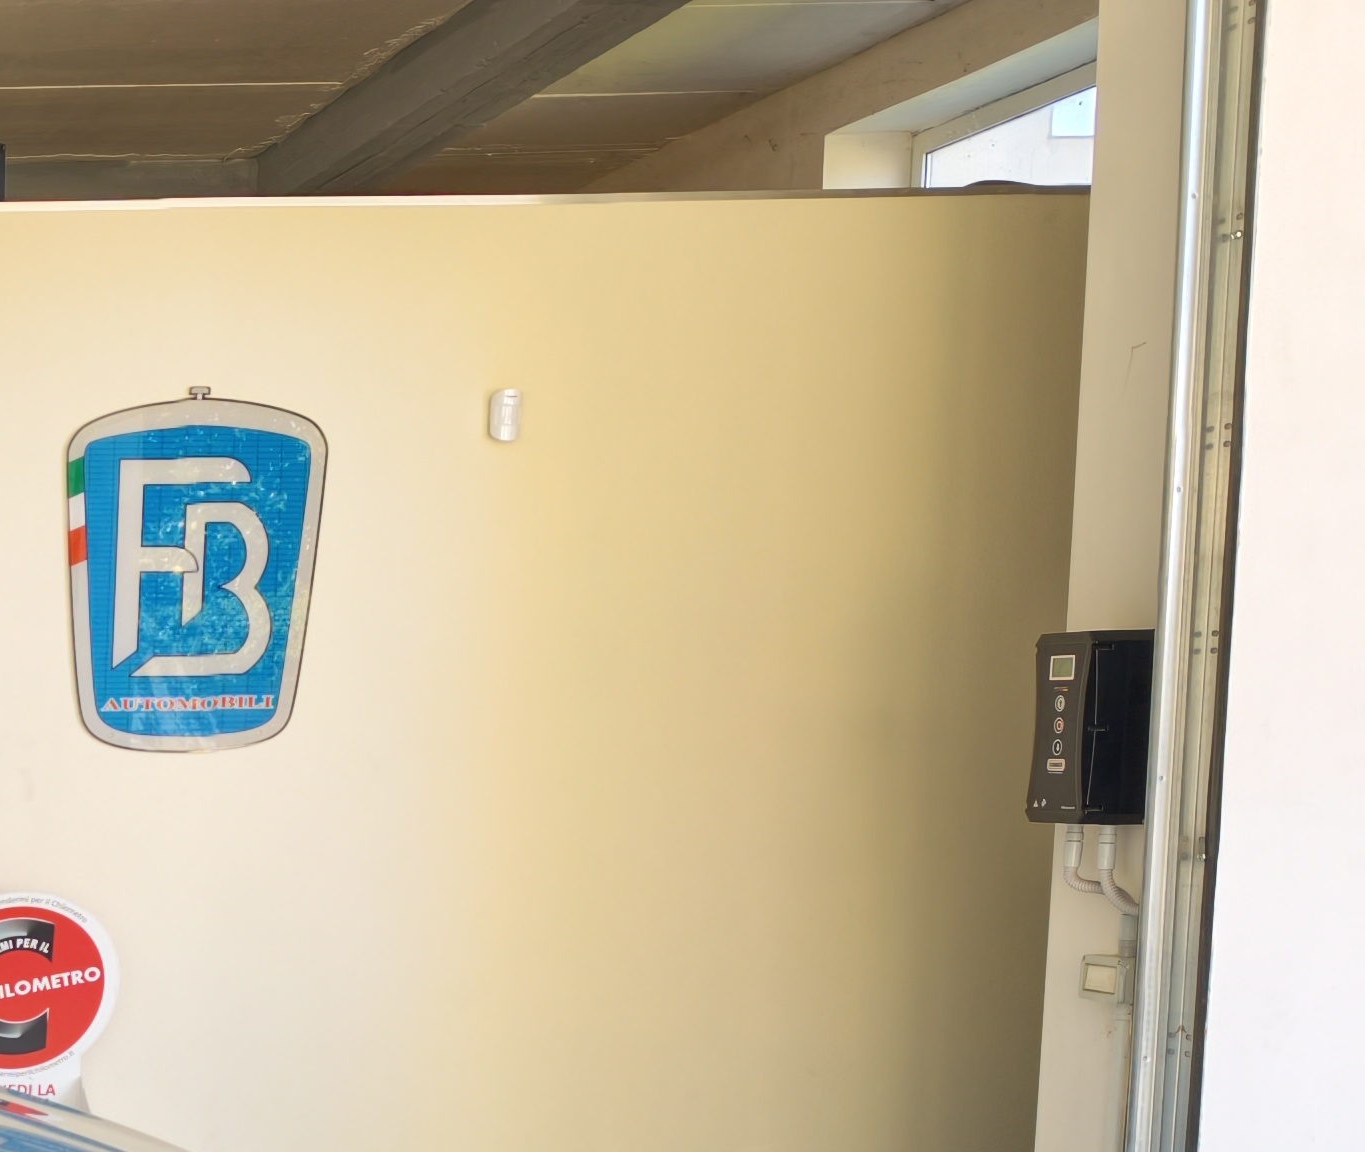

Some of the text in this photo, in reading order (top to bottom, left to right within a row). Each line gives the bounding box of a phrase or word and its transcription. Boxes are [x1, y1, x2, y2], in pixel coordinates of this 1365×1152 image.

[111, 456, 273, 677] FB
[101, 694, 274, 712] AUTOMOBILI
[16, 938, 38, 950] PER
[39, 941, 51, 954] IL
[38, 1083, 56, 1096] LA
